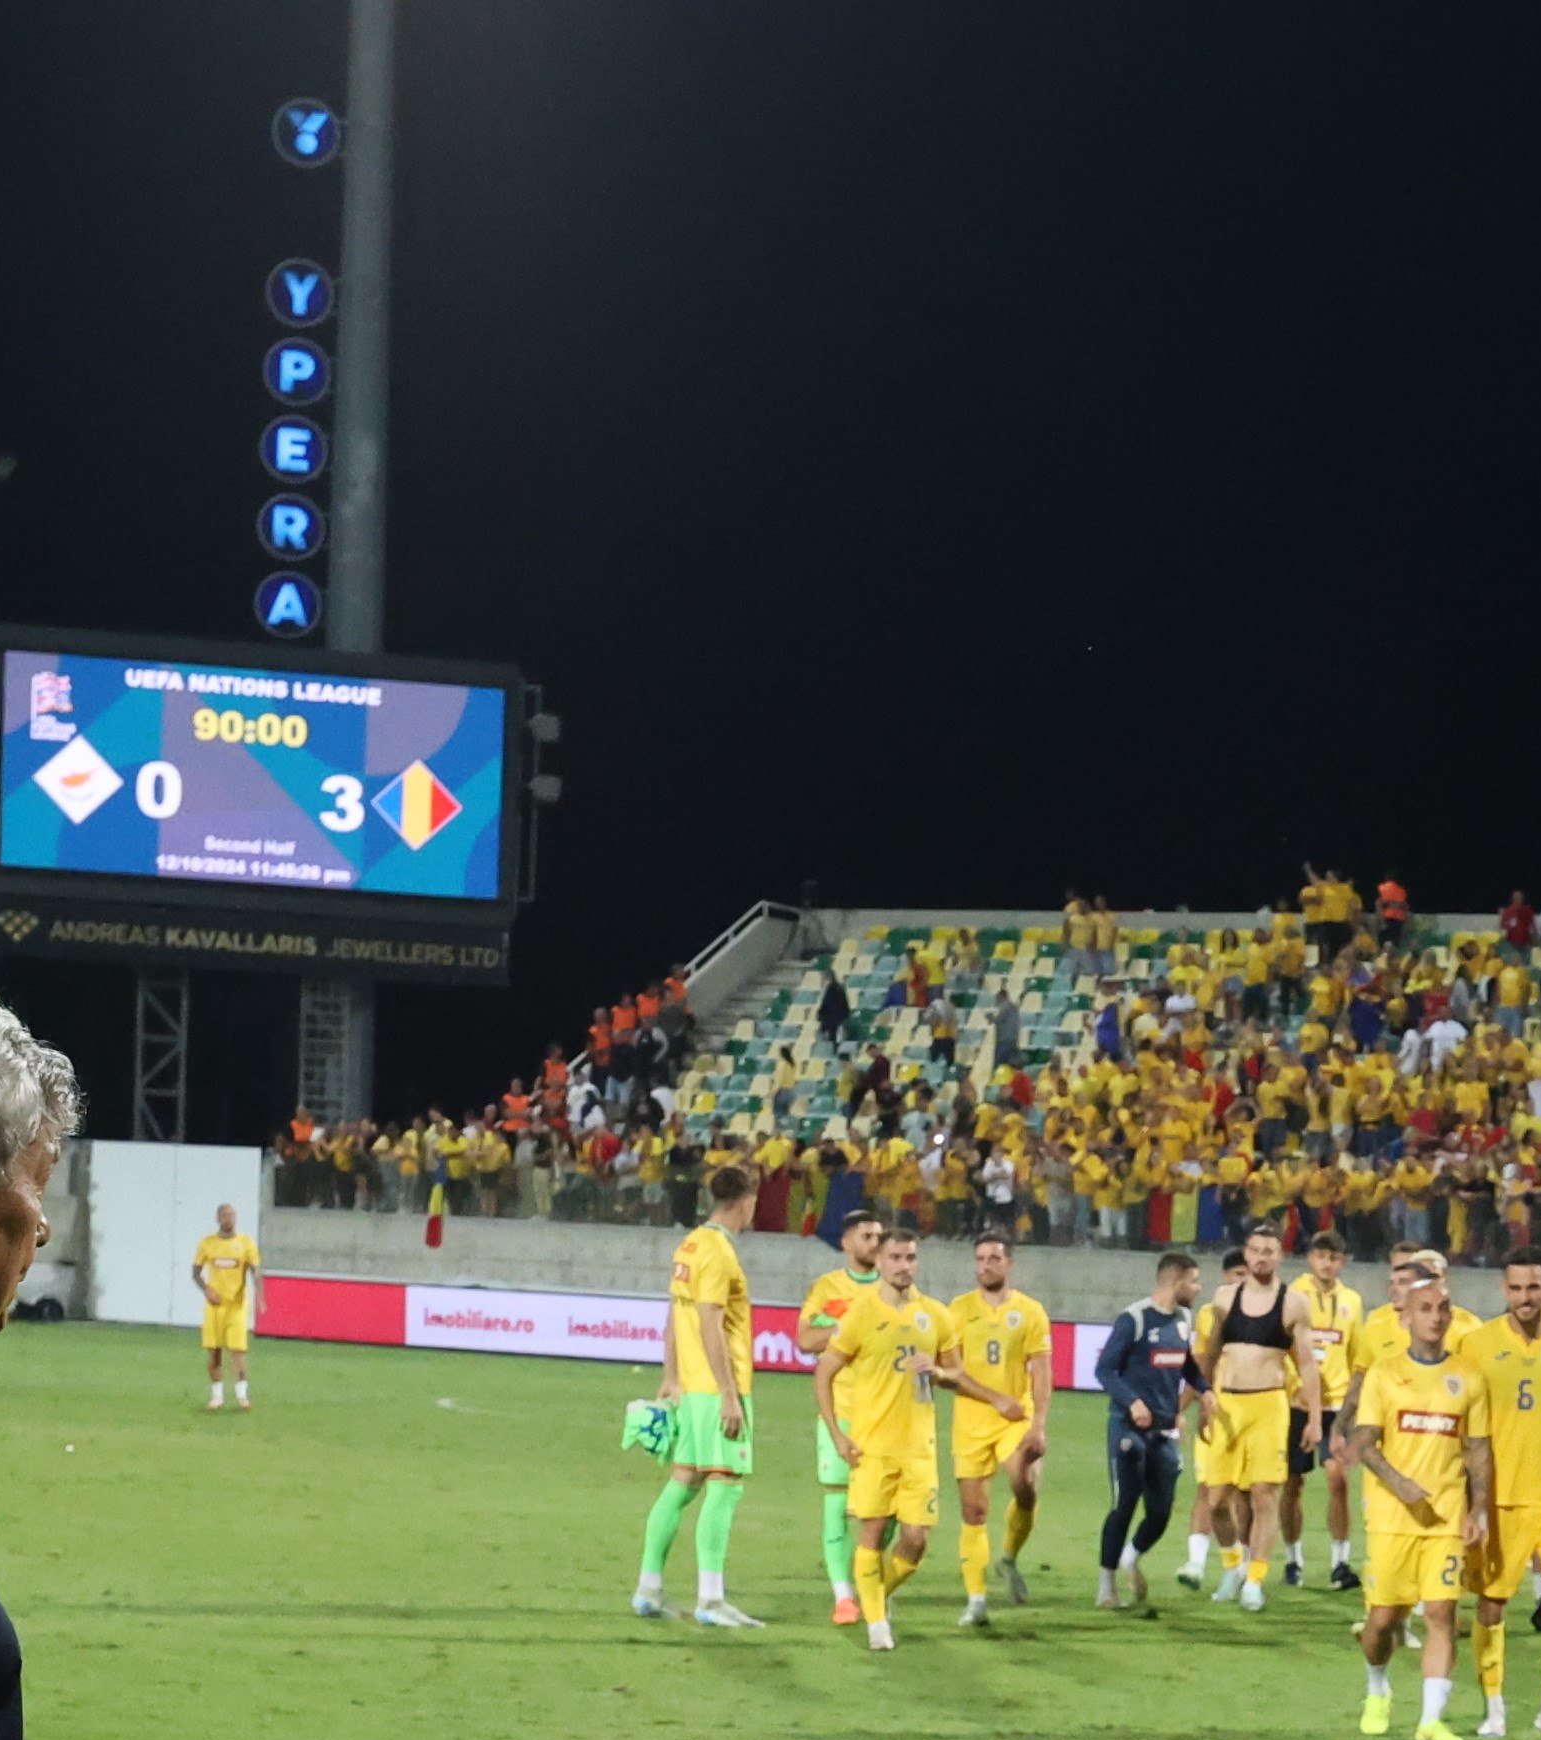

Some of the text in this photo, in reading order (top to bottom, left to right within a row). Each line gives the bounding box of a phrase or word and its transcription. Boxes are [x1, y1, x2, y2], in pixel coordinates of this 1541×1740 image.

[124, 668, 383, 707] UEFA NATIONS LEAGUE
[192, 708, 308, 749] 90:00
[135, 760, 183, 819] 0
[319, 774, 365, 833] 3
[49, 919, 499, 969] ANDREAS KAVALLARIS JEWELLERS LTD
[423, 1307, 535, 1333] imobiliare.ro
[986, 1341, 1001, 1365] 8
[1517, 1379, 1534, 1410] 6
